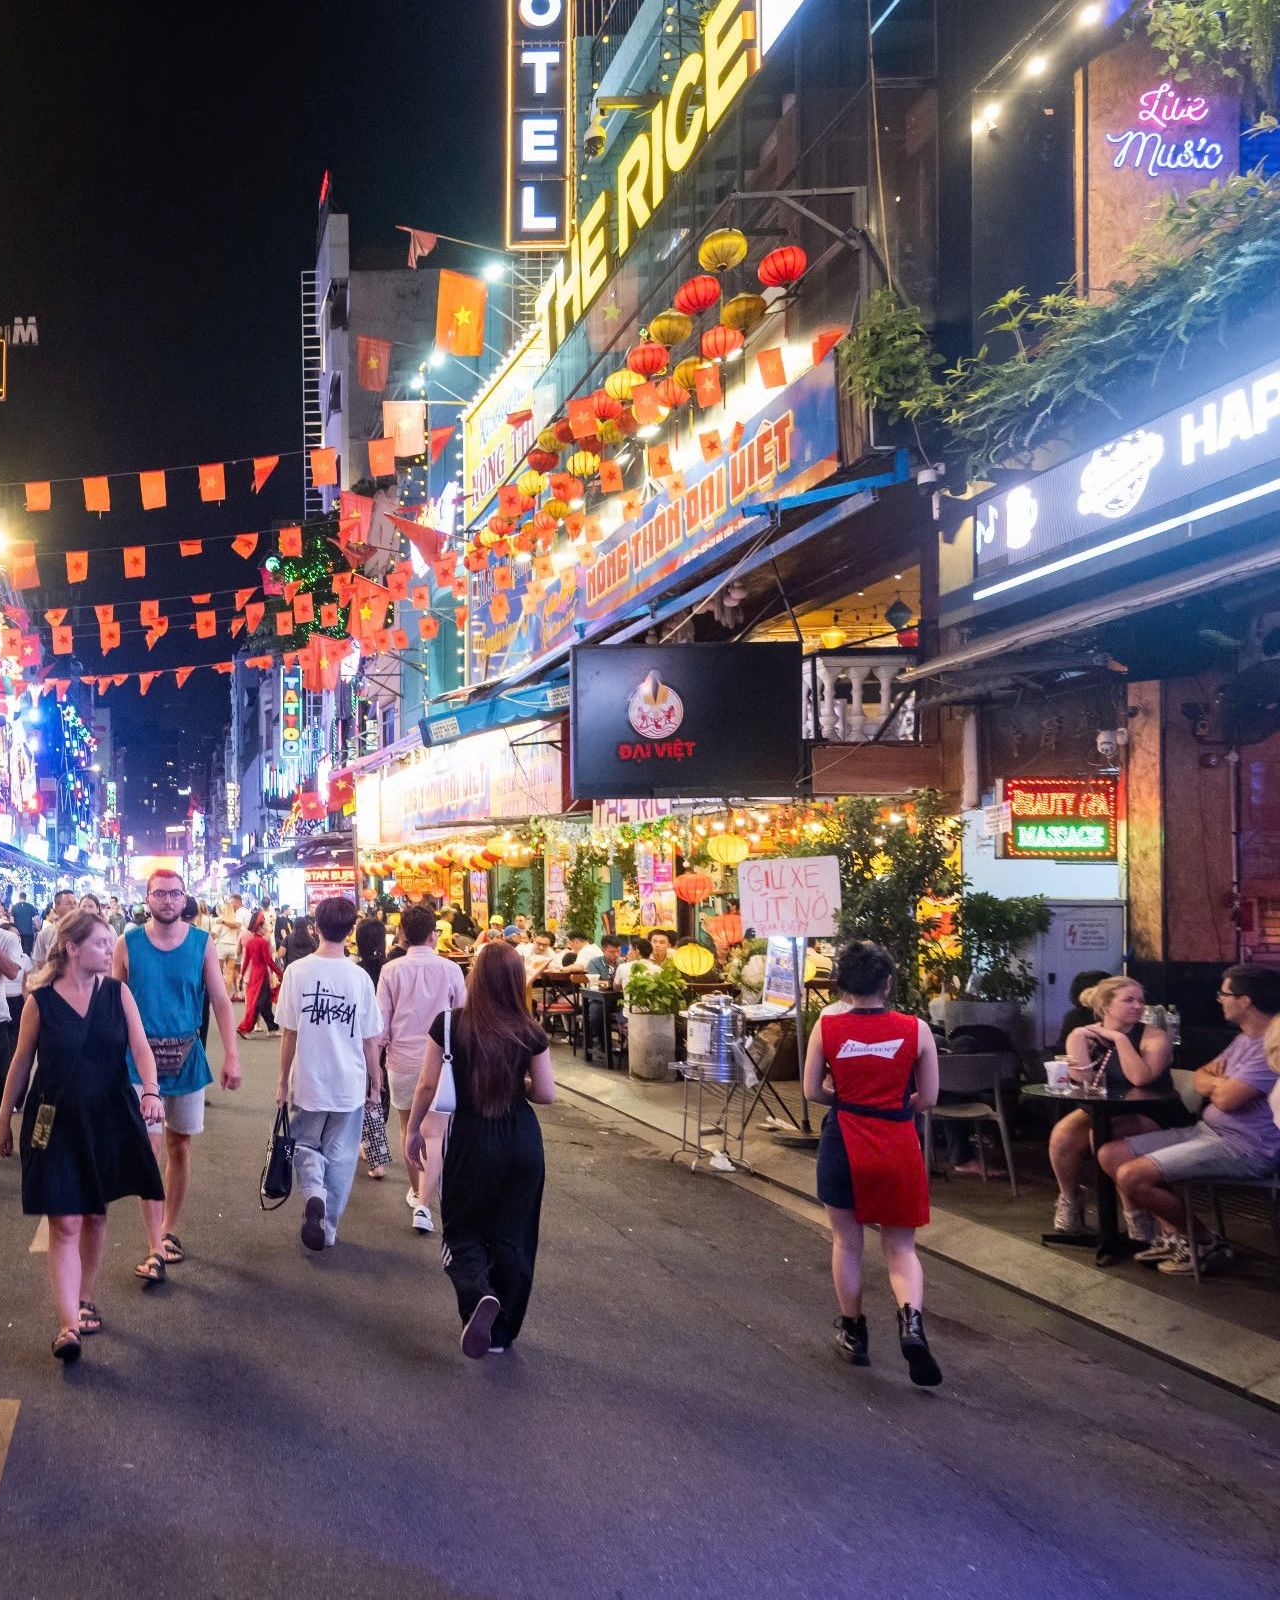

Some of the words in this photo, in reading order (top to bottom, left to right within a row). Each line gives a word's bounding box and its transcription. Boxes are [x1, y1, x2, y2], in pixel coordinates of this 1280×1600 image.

[1138, 83, 1209, 128] Live
[1106, 131, 1224, 177] Music
[535, 192, 608, 363] THE
[617, 0, 749, 258] RICE
[586, 539, 630, 607] NÔNG
[631, 498, 683, 575] THÔN
[684, 463, 727, 538] ĐẠI
[729, 409, 795, 506] VIỆT
[283, 677, 300, 753] TATTOO
[618, 742, 651, 762] ĐẠI
[654, 738, 696, 761] VIỆT
[637, 799, 673, 820] RIC
[1017, 825, 1105, 848] MASSAGE
[791, 863, 819, 889] XE
